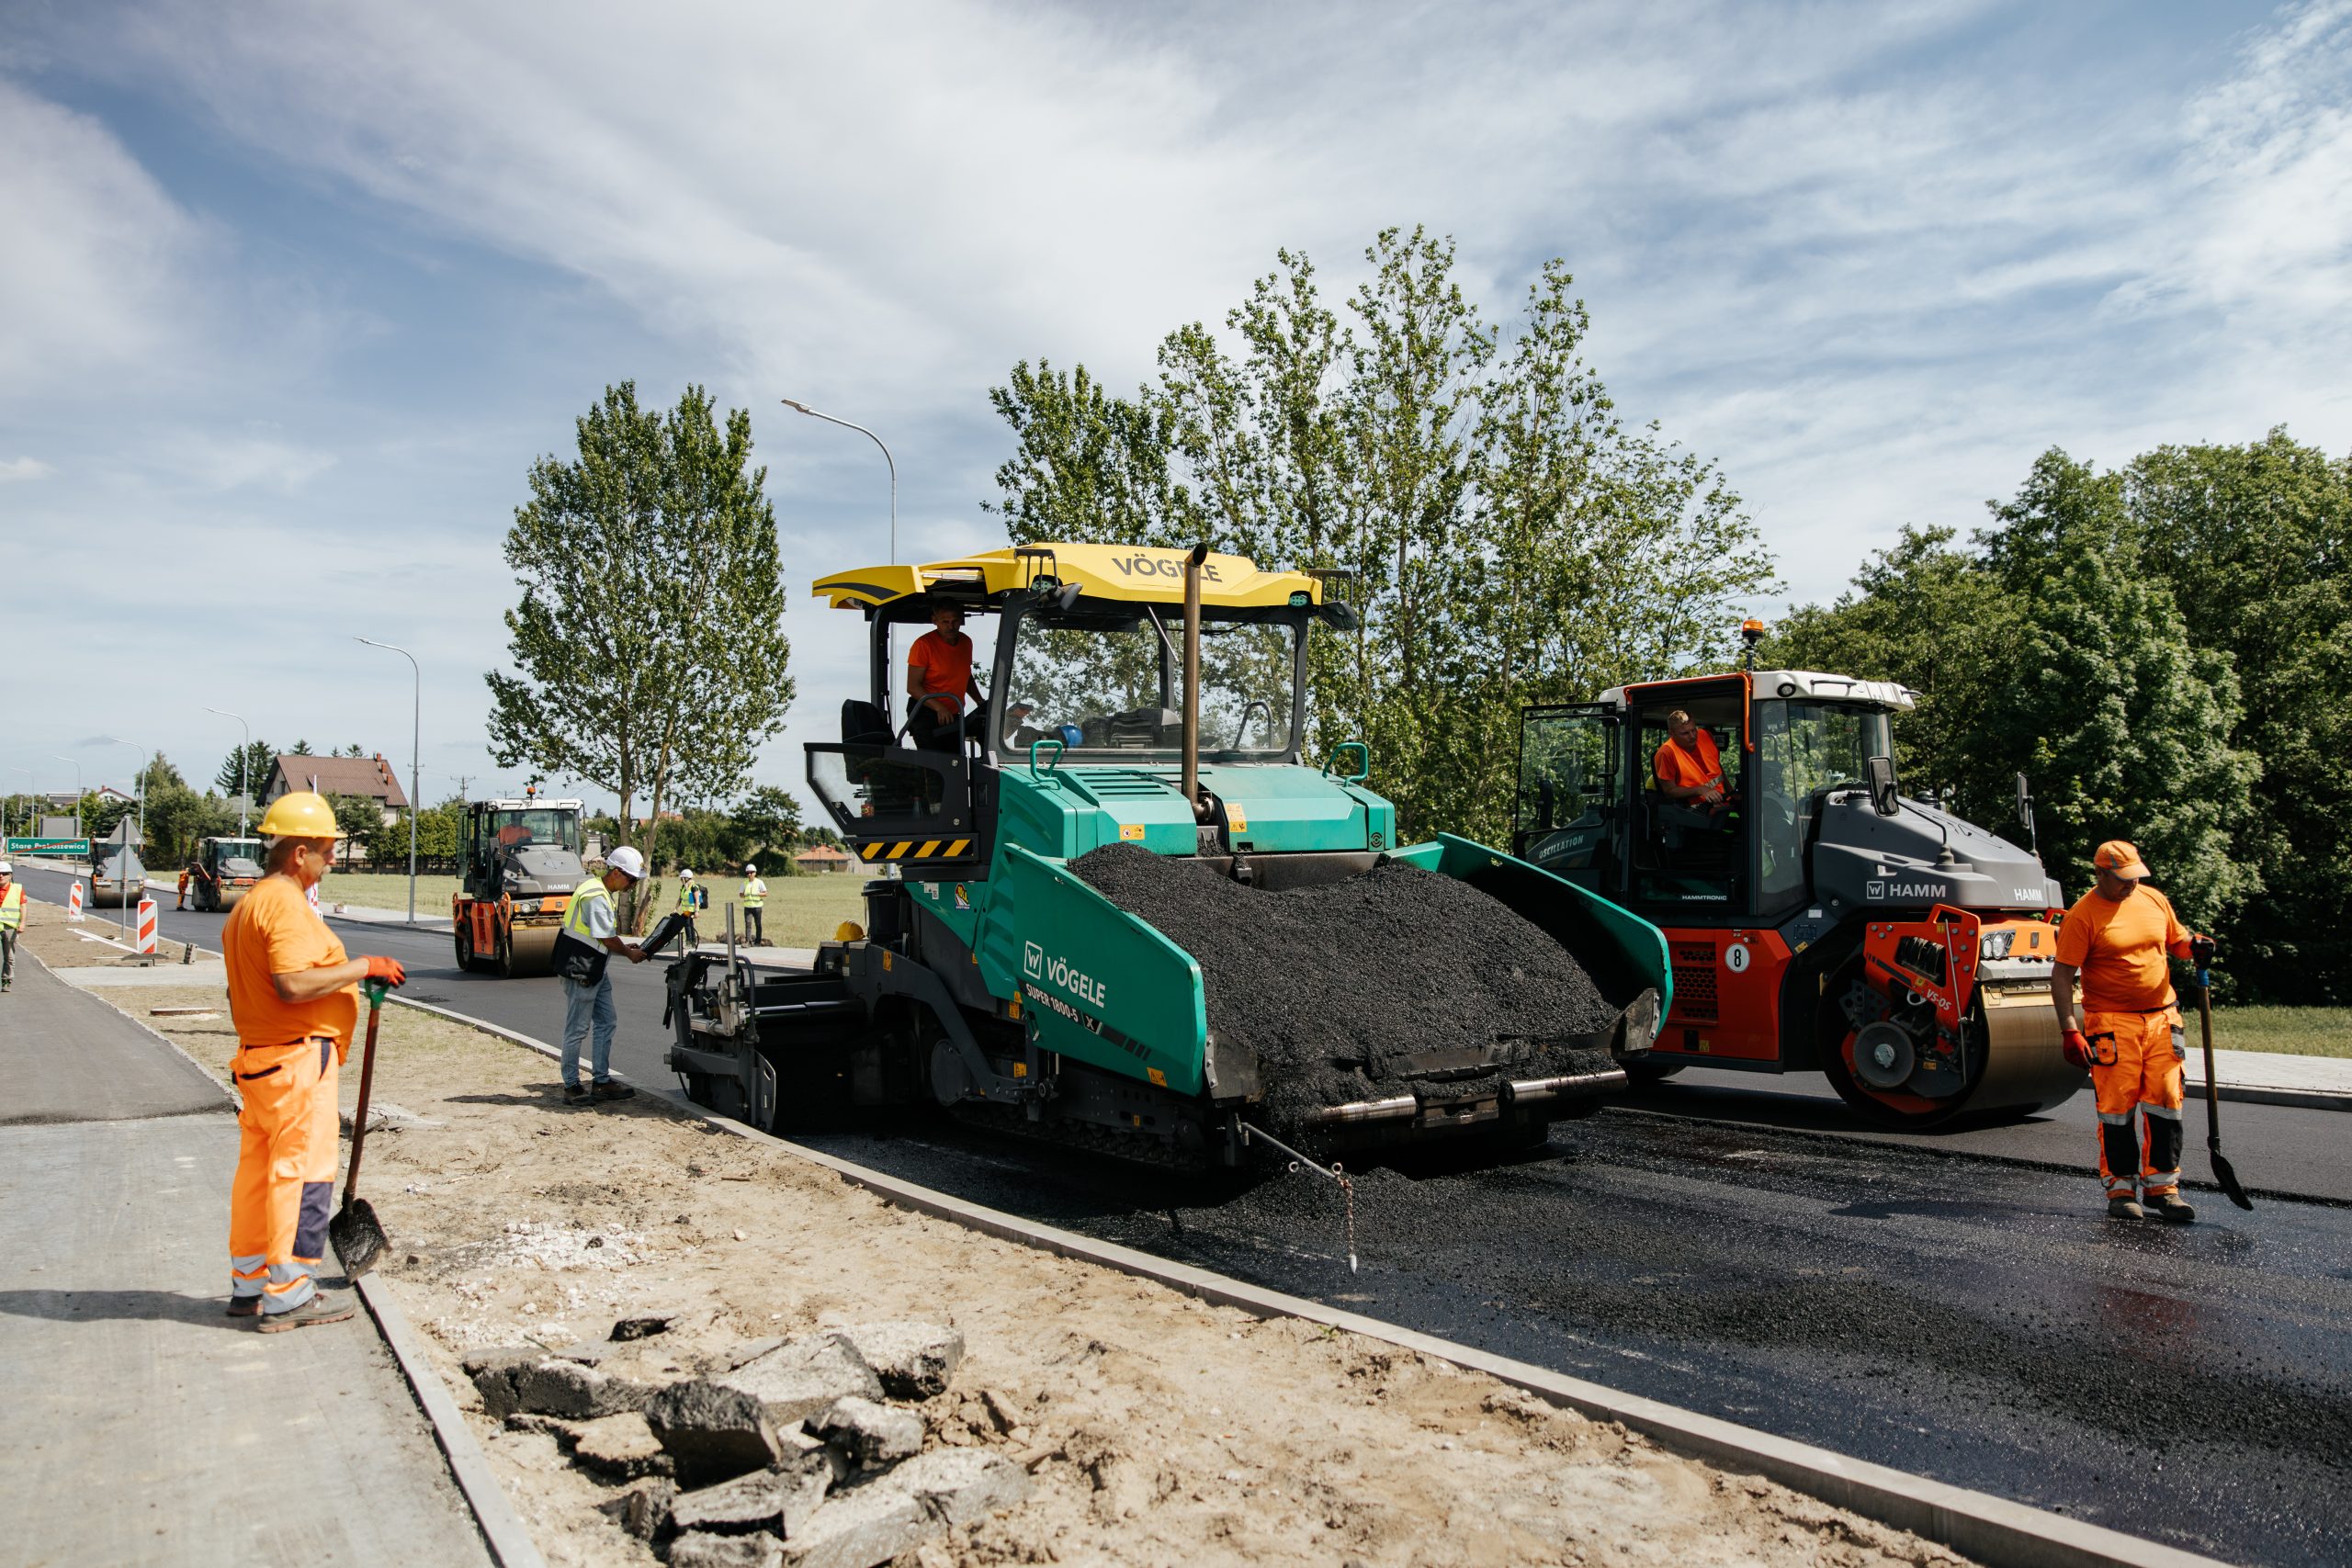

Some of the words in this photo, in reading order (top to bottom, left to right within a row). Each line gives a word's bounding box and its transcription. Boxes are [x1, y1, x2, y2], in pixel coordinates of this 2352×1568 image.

[1538, 834, 1584, 860] OSCILLATION
[1889, 884, 1947, 897] HAMM
[2013, 888, 2043, 902] HAMM
[1734, 949, 1742, 967] 8
[1046, 956, 1106, 1009] VÖGELE
[1025, 983, 1051, 1008] SUPER
[1050, 997, 1079, 1022] 1800-5
[1926, 988, 1952, 1010] VS-OS
